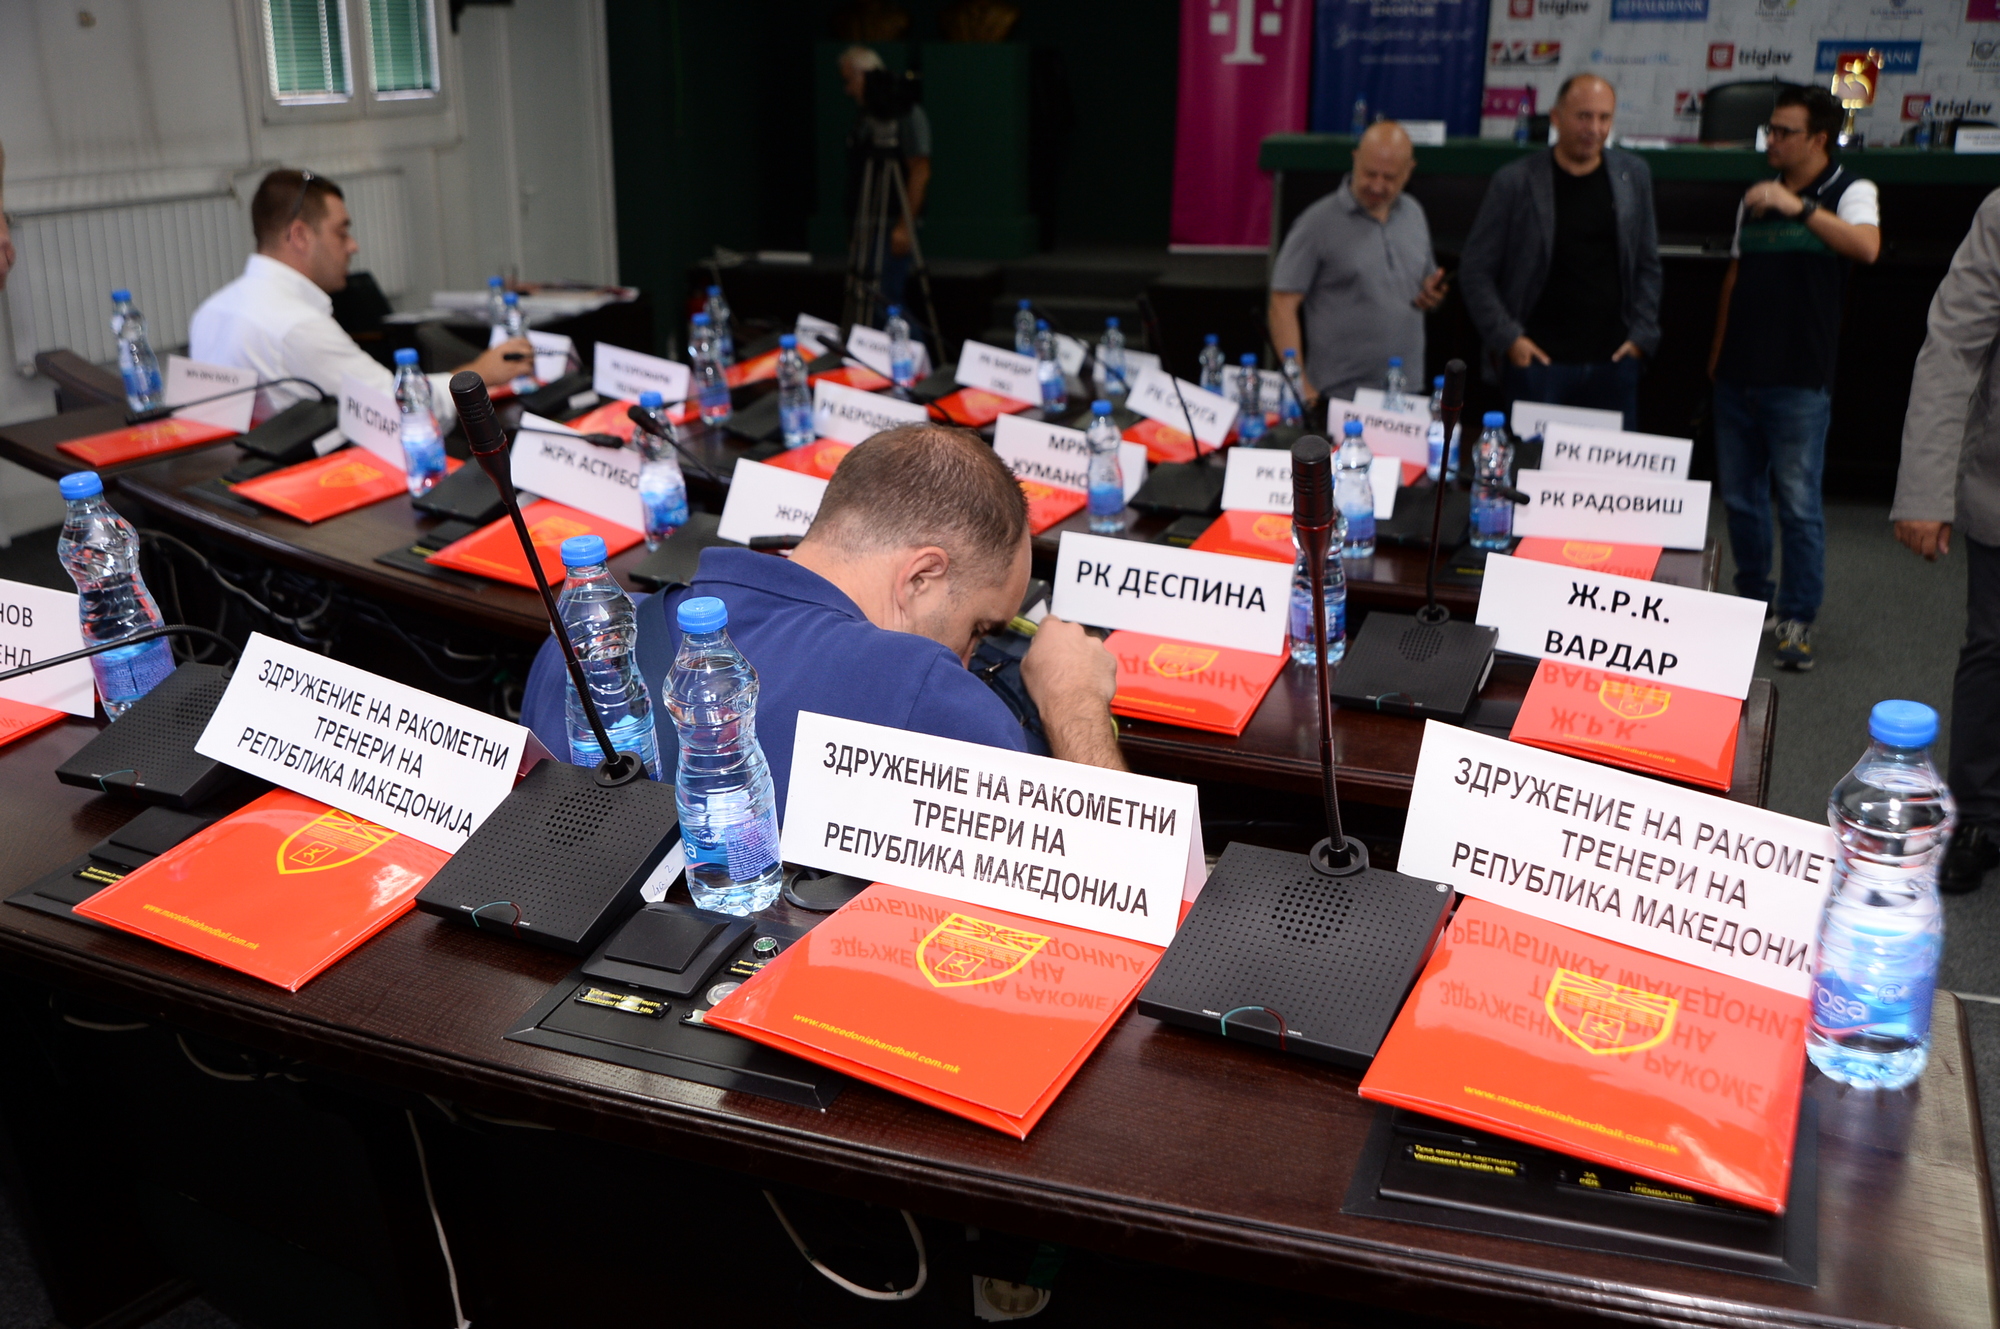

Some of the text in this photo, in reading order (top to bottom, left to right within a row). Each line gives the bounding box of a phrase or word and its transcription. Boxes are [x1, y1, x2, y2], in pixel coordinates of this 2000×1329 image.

[1739, 47, 1792, 68] triglav
[1935, 100, 1992, 120] triglav
[365, 405, 401, 436] СПАР
[1364, 414, 1421, 437] ПРОЛЕТ
[578, 455, 640, 489] АСТИБО
[1012, 457, 1089, 489] КУМАНО
[1556, 441, 1677, 473] РК ПРИЛЕП
[775, 504, 814, 526] ЖРК
[1540, 490, 1684, 514] РК РАДОВИШ
[1076, 560, 1267, 613] РК ДЕСПИНА
[1567, 581, 1671, 624] Ж.Р.К.
[1544, 629, 1679, 676] ВАРДАР
[257, 659, 511, 771] ЗДРУЖЕНИЕ НА РАКОМЕТНИ
[315, 716, 424, 778] ТРЕНЕРИ НА
[237, 726, 475, 838] РЕПУБЛИКА МАКЕДОНИЈА
[822, 742, 1178, 837] ЗДРУЖЕНИЕ НА РАКОМЕТНИ
[912, 800, 1067, 857] ТРЕНЕРИ НА
[1453, 757, 1836, 885] ЗДРУЖЕНИЕ НА РАКОМЕ
[823, 822, 966, 878] РЕПУБЛИКА
[973, 853, 1150, 917] МАКЕДОНИЈА
[1561, 829, 1748, 910] ТРЕНЕРИ НА
[143, 901, 261, 951] www.macedoniahandball.com.mk
[1451, 841, 1811, 974] РЕПУБЛИКА МАКЕДОНИ
[792, 1012, 961, 1075] www.macedoniahandball.com.mk
[1463, 1084, 1680, 1155] www.macedoniahandball.com.mk
